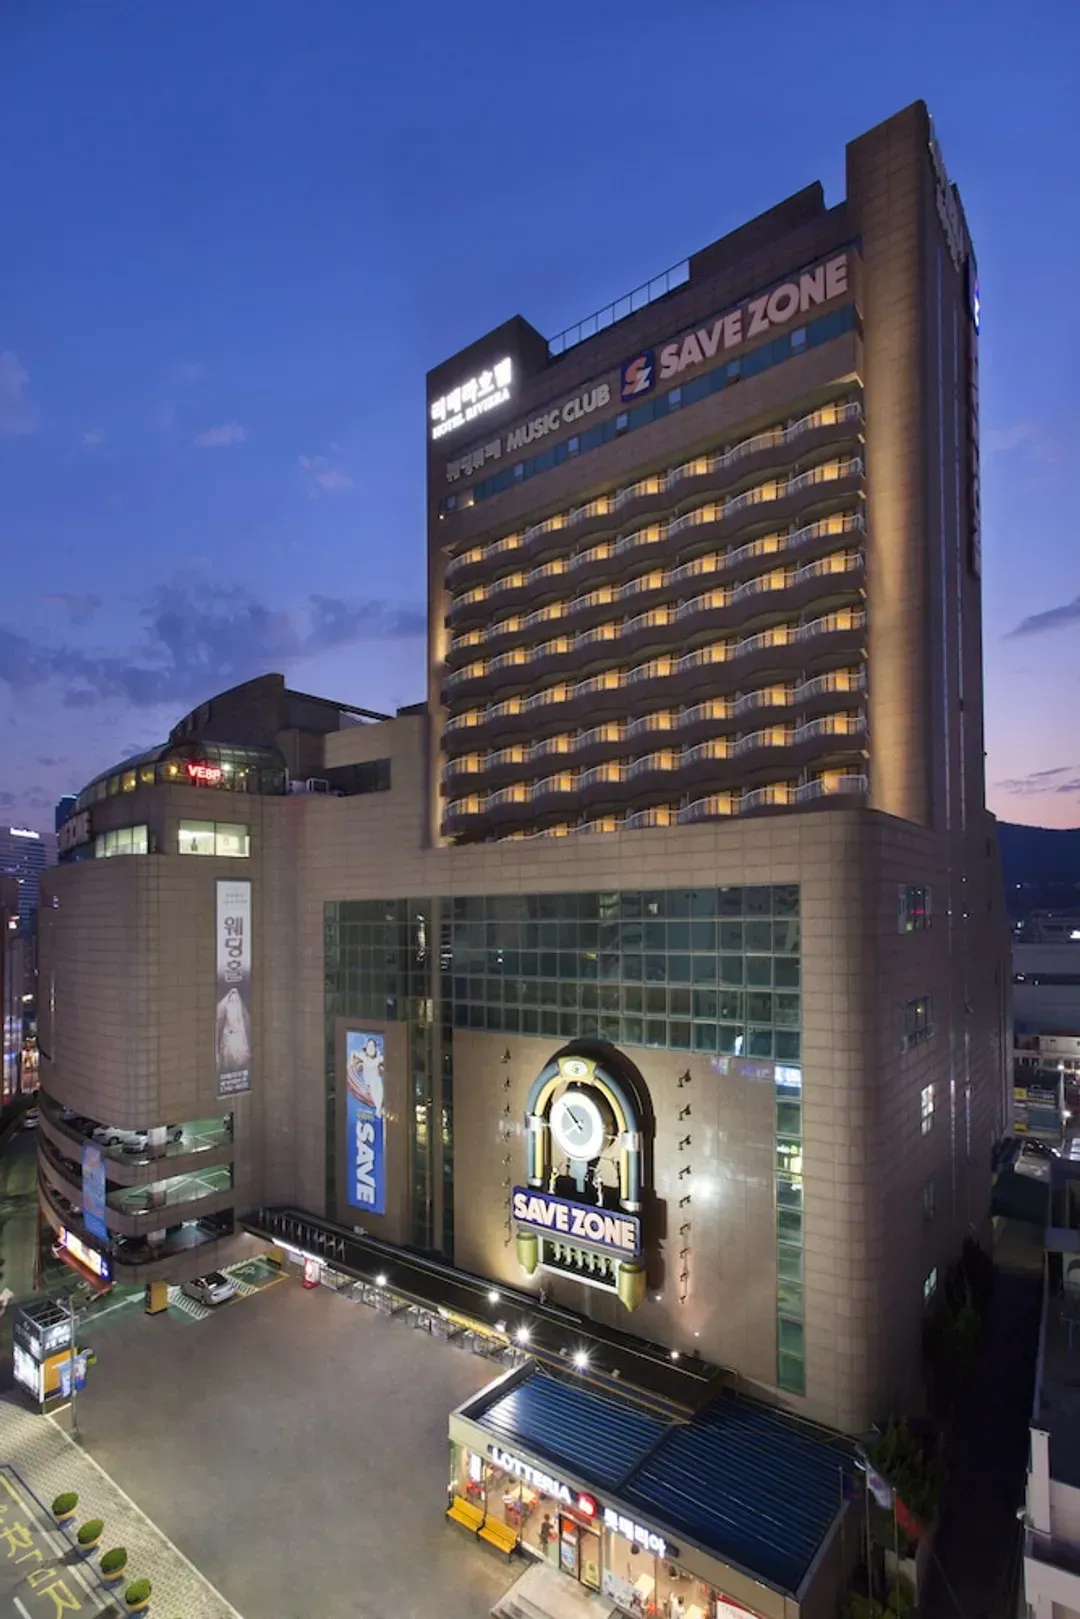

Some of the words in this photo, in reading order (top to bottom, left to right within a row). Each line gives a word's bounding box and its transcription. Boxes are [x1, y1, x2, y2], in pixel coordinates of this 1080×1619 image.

[659, 309, 743, 380] SAVE
[747, 253, 849, 338] ZONE
[506, 409, 560, 453] MUSIC
[562, 383, 611, 423] CLUB
[356, 1119, 377, 1205] SAVE
[513, 1193, 569, 1232] SAVE
[570, 1207, 636, 1250] ZONE
[491, 1446, 573, 1506] LOTTERIA
